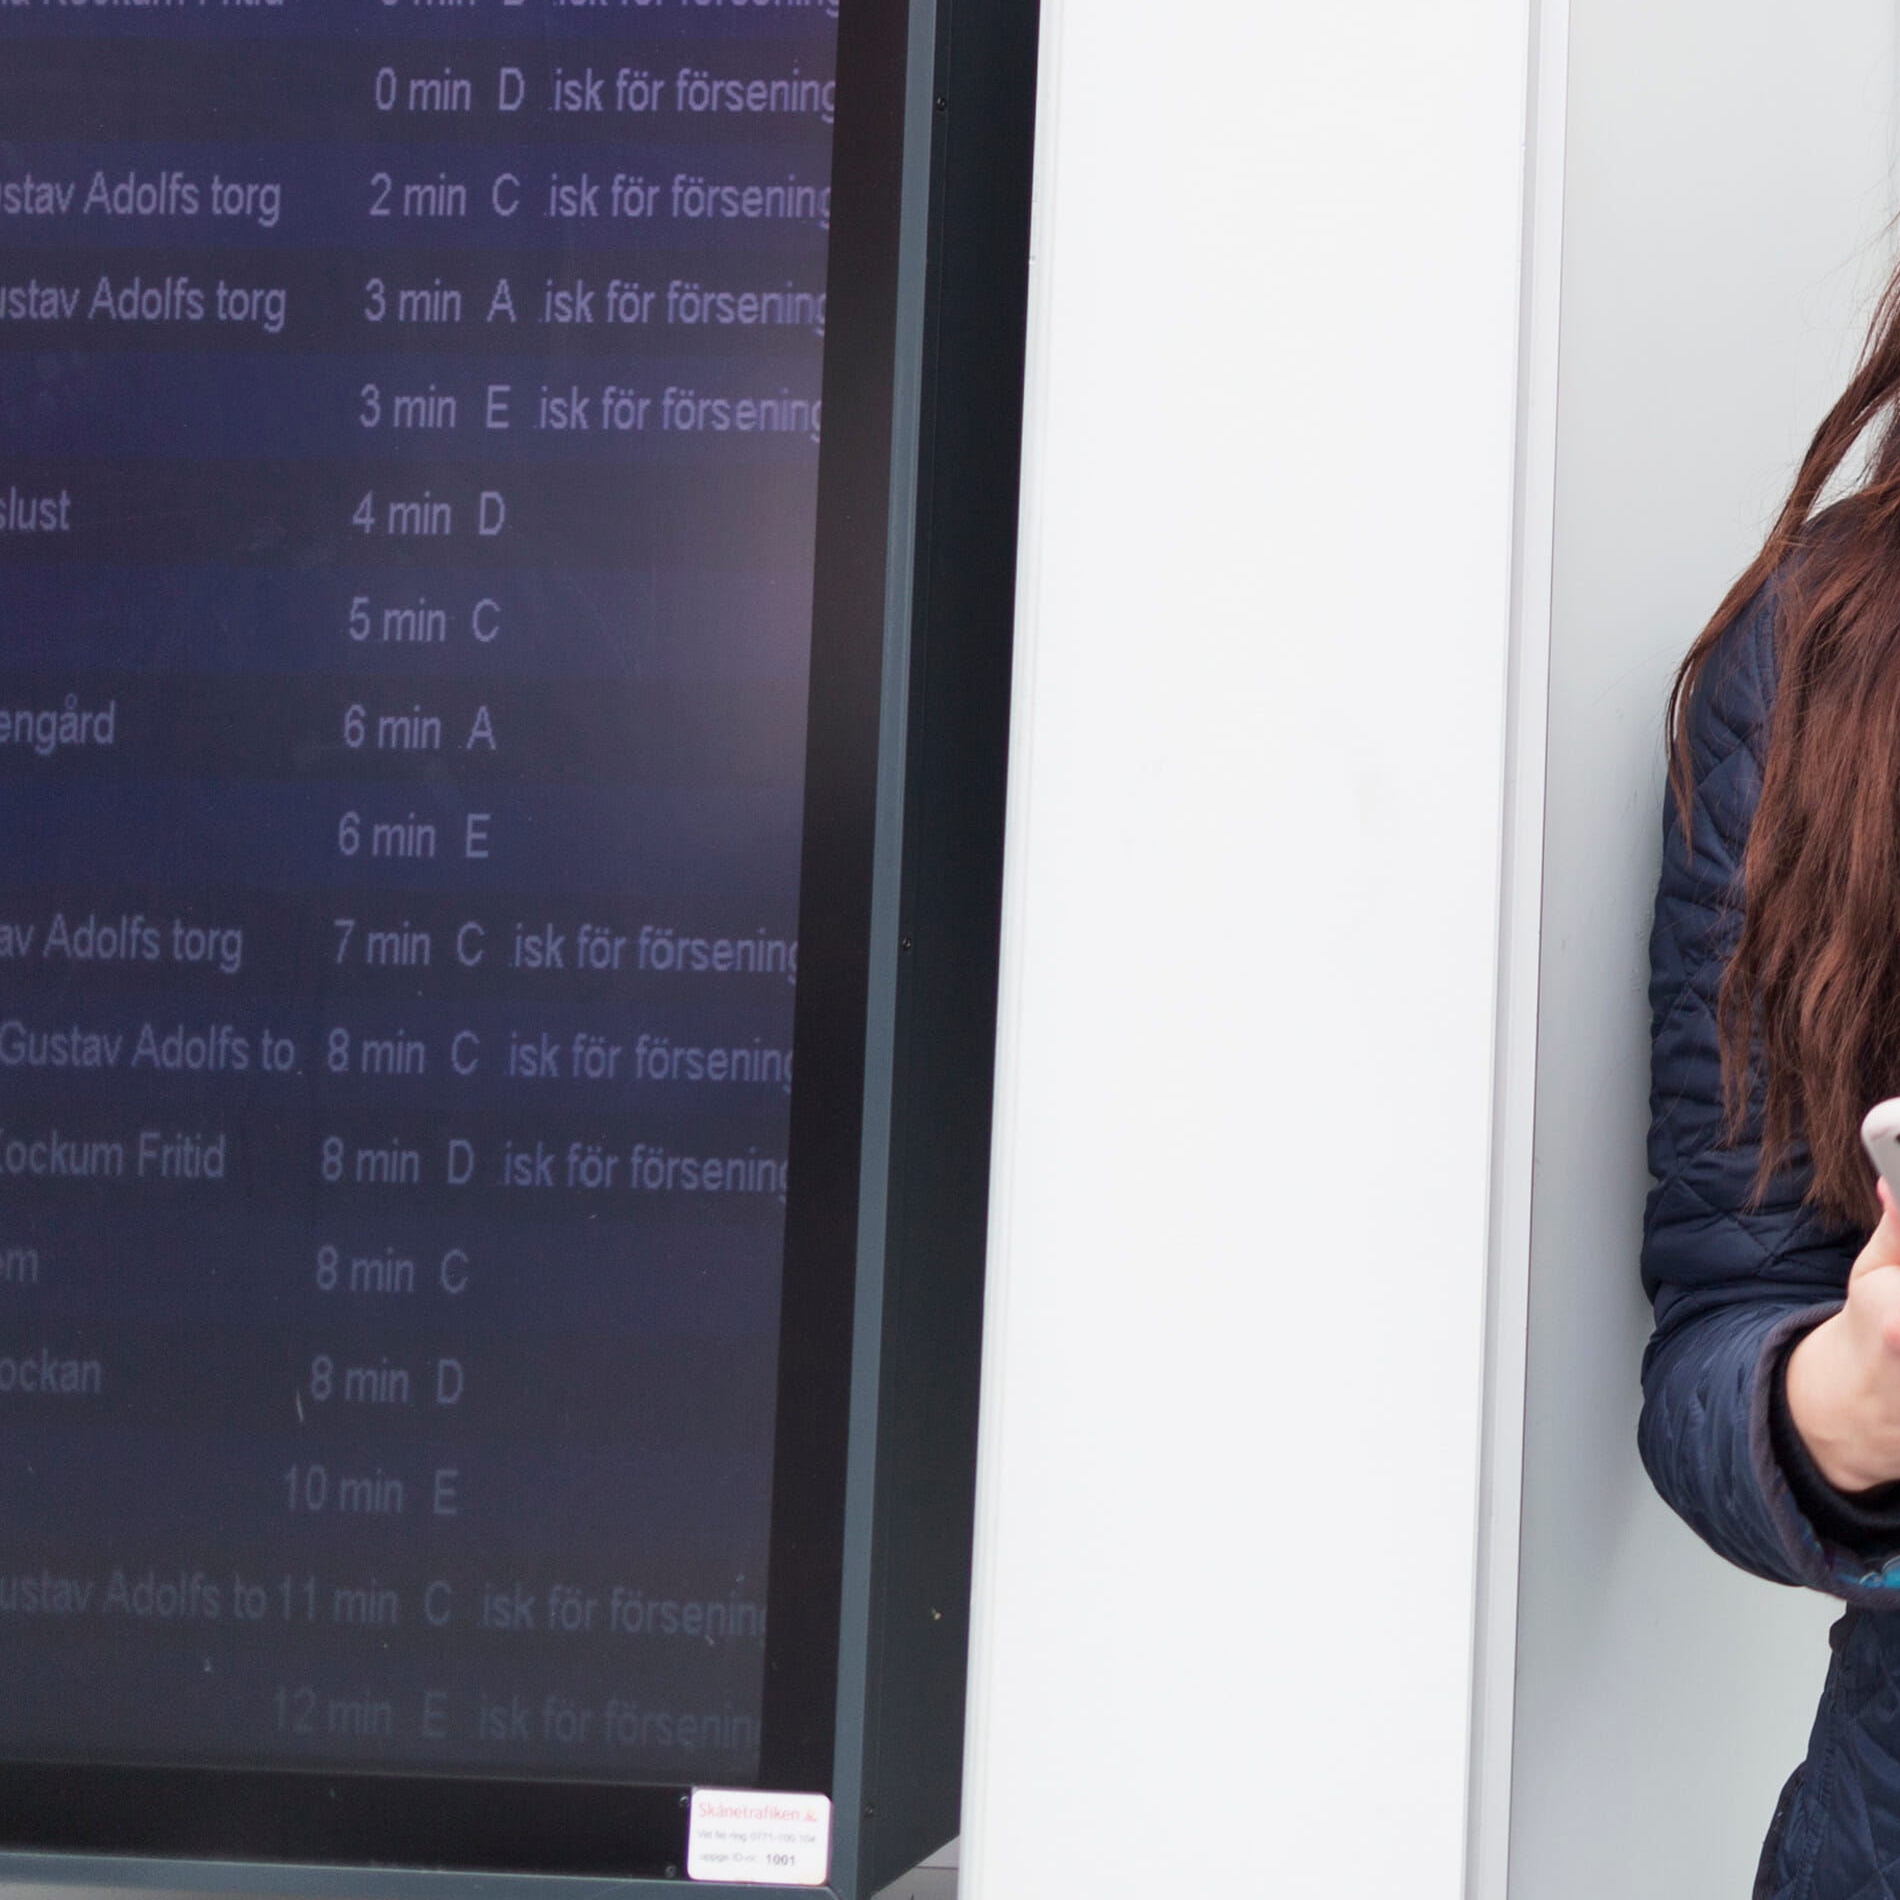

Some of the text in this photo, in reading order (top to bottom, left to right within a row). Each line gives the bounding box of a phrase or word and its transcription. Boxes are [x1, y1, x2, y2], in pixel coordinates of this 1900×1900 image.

[375, 66, 396, 111] 0
[409, 67, 471, 111] min
[499, 65, 525, 111] D
[555, 66, 602, 114] isk
[617, 67, 663, 114] för
[3, 174, 75, 215] stav
[84, 171, 200, 216] Adolfs
[211, 174, 281, 228] torg
[370, 172, 391, 216] 2
[404, 173, 465, 216] min
[492, 171, 520, 216] C
[550, 172, 596, 220] isk
[611, 173, 657, 221] för
[89, 276, 205, 322] Adolfs
[217, 280, 286, 332] torg
[365, 278, 386, 322] 3
[399, 278, 461, 322] min
[487, 276, 517, 322] A
[546, 278, 592, 325] isk
[607, 278, 653, 326] för
[360, 383, 381, 429] 3
[394, 385, 456, 429] min
[487, 383, 510, 429] E
[541, 383, 587, 431] isk
[602, 384, 648, 432] för
[352, 490, 374, 535] 4
[389, 491, 451, 535] min
[480, 489, 506, 535] D
[349, 596, 500, 641] 5 min C
[344, 704, 365, 749] 6
[379, 705, 441, 749] min
[467, 703, 496, 749] A
[339, 812, 490, 857] 6 min E
[44, 914, 161, 961] Adolfs
[173, 918, 243, 972] torg
[334, 918, 354, 963] 7
[368, 920, 430, 965] min
[457, 920, 485, 965] C
[515, 922, 562, 970] isk
[0, 1020, 122, 1067] Gustav
[133, 1021, 250, 1069] Adolfs
[262, 1027, 294, 1069] to
[328, 1027, 349, 1072] 8
[362, 1028, 425, 1074] min
[451, 1029, 480, 1075] C
[510, 1031, 556, 1079] isk
[571, 1032, 617, 1079] för
[0, 1131, 124, 1177] ockum
[138, 1132, 225, 1179] Fritid
[321, 1136, 343, 1182] 8
[357, 1136, 420, 1183] min
[449, 1139, 475, 1184] D
[505, 1141, 551, 1189] isk
[566, 1142, 612, 1190] för
[316, 1245, 338, 1291] 8
[351, 1246, 415, 1292] min
[441, 1248, 469, 1293] C
[311, 1355, 332, 1400] 8
[345, 1357, 409, 1403] min
[437, 1358, 464, 1404] D
[283, 1464, 458, 1514] 10 min E
[104, 1571, 221, 1618] Adolfs
[233, 1577, 266, 1620] to
[279, 1576, 320, 1620] 11
[334, 1578, 397, 1622] min
[425, 1579, 454, 1625] C
[484, 1584, 531, 1632] isk
[546, 1585, 592, 1632] för
[273, 1686, 315, 1733] 12
[329, 1688, 392, 1736] min
[423, 1691, 447, 1739] E
[480, 1694, 527, 1741] isk
[601, 1694, 759, 1752] försenin
[766, 1854, 796, 1866] 1001
